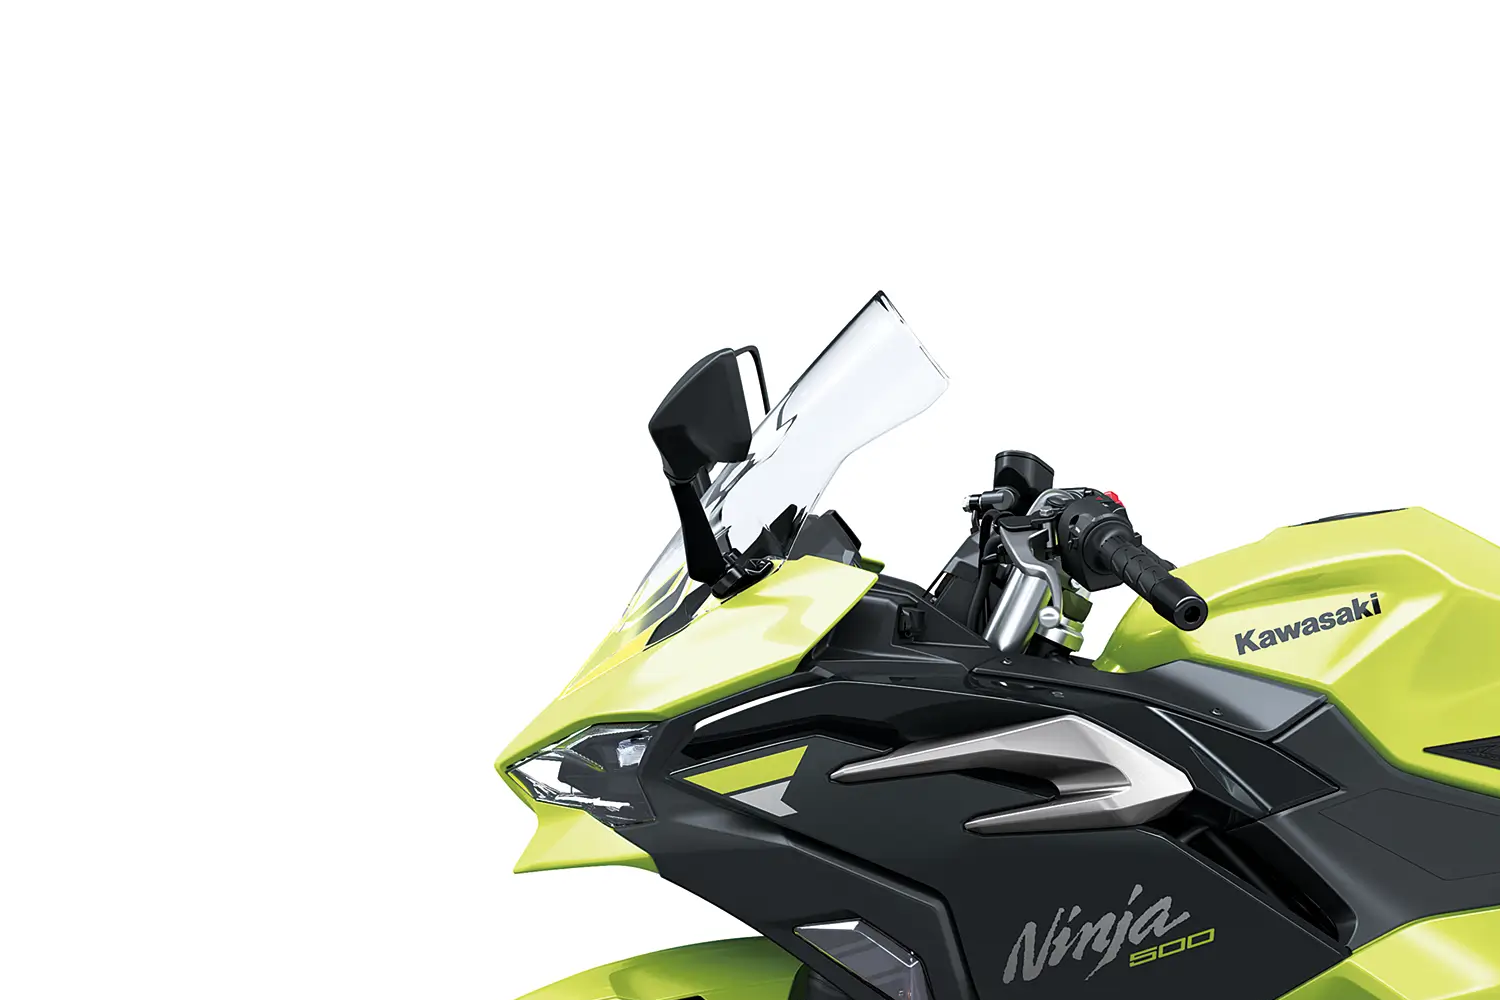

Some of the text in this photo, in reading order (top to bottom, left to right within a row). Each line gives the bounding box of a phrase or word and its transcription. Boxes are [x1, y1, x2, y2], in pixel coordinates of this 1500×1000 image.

[1234, 592, 1382, 656] Kawasaki
[1002, 883, 1190, 984] Ninja
[1129, 927, 1215, 967] 500
